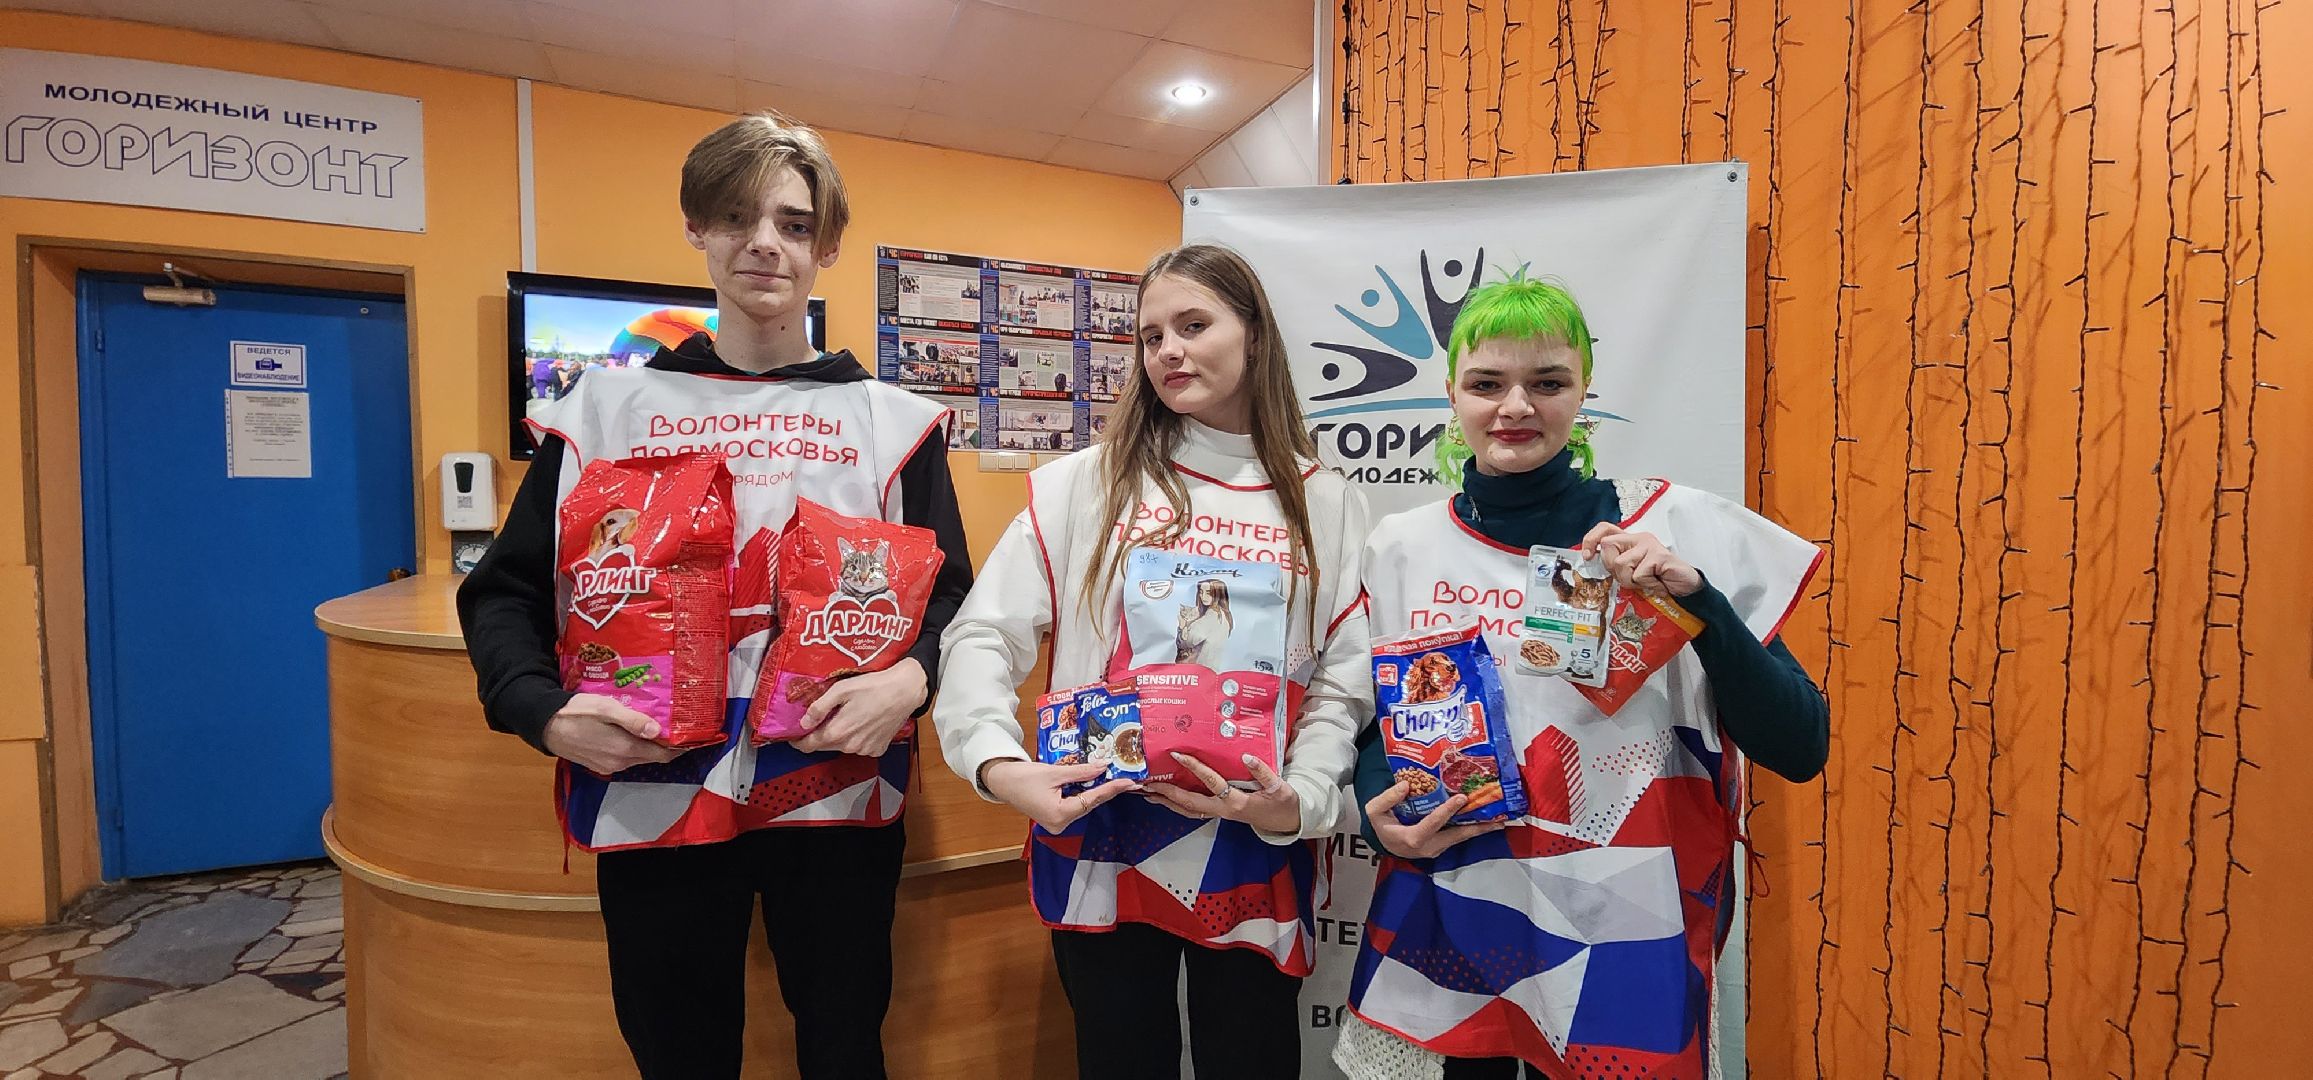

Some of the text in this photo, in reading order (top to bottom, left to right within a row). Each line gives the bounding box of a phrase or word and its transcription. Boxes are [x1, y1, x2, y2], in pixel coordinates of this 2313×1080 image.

[45, 83, 378, 136] МОЛОДЕЖНЫЙ ЦЕНТР
[5, 115, 409, 199] ГОРИЗОНТ
[247, 347, 291, 355] ВЕДЕТСЯ
[238, 372, 300, 381] ВИДЕОНАБЛЮДЕНИЕ
[650, 413, 842, 438] ВОЛОНТЕРЫ
[1310, 423, 1446, 459] ГОРИ
[1432, 580, 1524, 610] ВОЛО
[1535, 606, 1592, 622] PERFECT FIT
[802, 610, 912, 645] ДАРЛИНГ
[1581, 649, 1592, 659] 5
[1136, 675, 1198, 686] SENSITIVE
